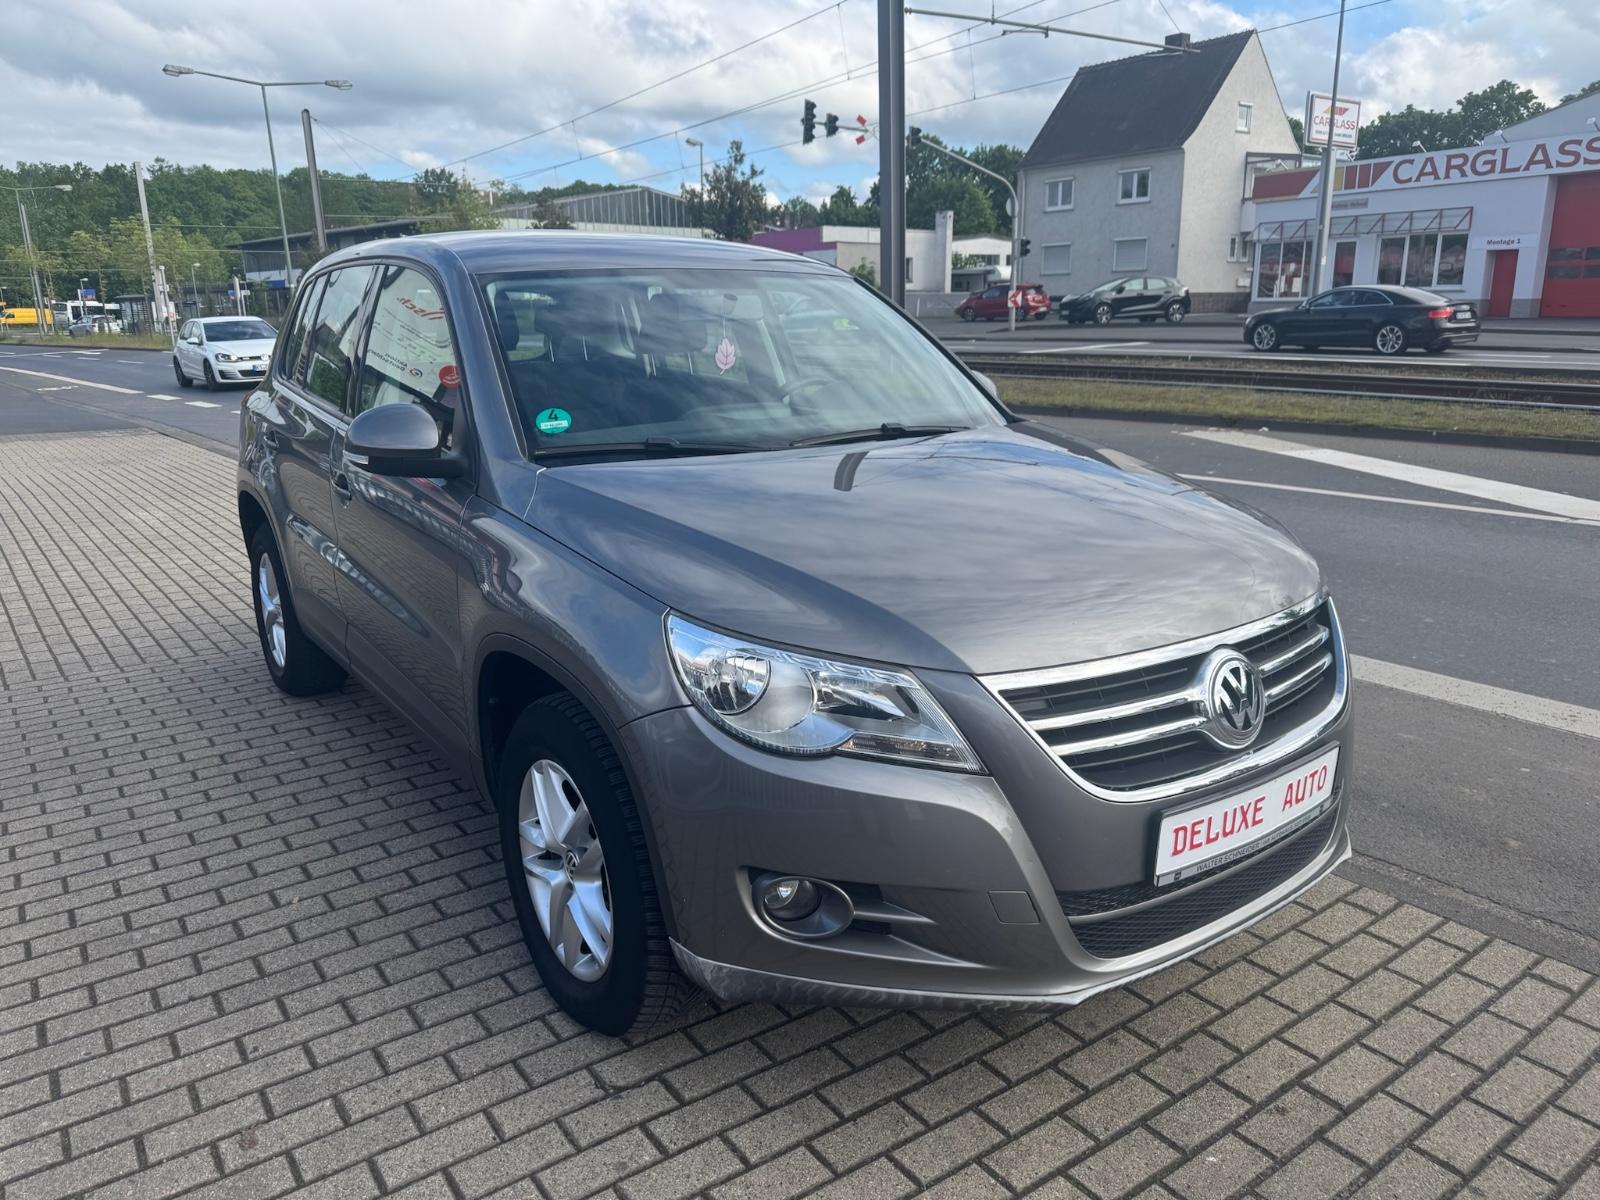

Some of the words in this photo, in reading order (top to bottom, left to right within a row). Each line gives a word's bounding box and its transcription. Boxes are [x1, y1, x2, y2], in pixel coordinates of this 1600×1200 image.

[1313, 115, 1356, 130] CARLASS
[548, 409, 558, 421] 4
[1170, 796, 1266, 857] DELUXE
[1281, 764, 1328, 812] AUTO
[1196, 857, 1223, 873] WALTER
